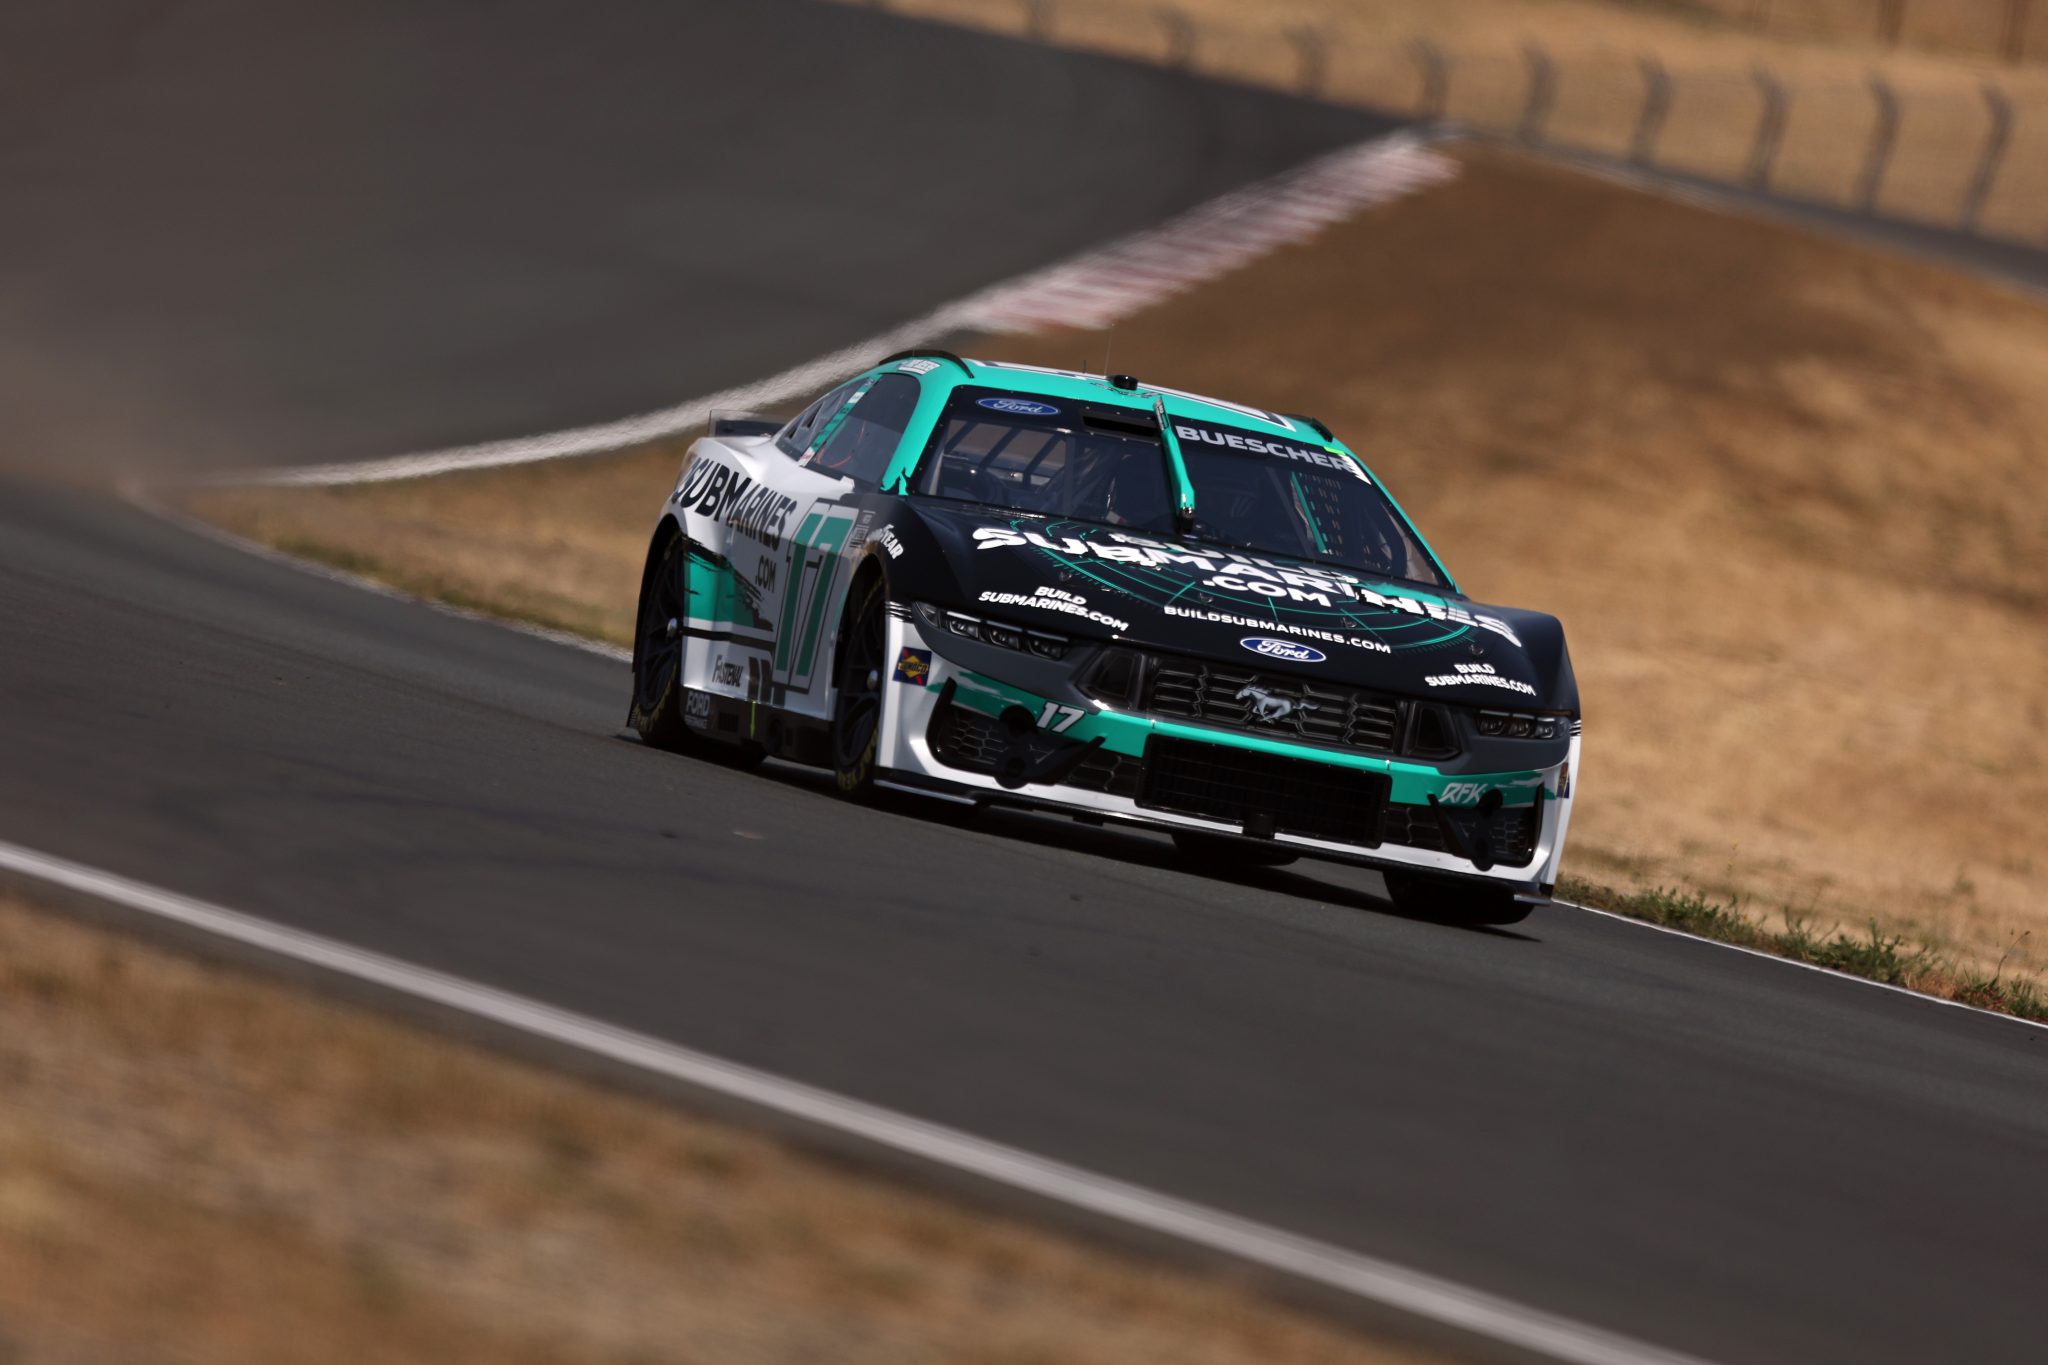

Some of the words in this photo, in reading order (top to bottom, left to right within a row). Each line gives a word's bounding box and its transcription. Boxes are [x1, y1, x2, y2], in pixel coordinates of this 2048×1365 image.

[1175, 424, 1357, 473] BUESCHER
[671, 456, 798, 552] SUBMARINES
[755, 554, 777, 593] .COM
[973, 527, 1523, 648] SUBMARINES
[1202, 575, 1332, 607] .COM
[770, 500, 859, 692] 17
[978, 590, 1130, 632] SUBMARINES.COM
[1034, 585, 1087, 606] BUILD
[1163, 605, 1393, 655] BUILDSUBMARINES.COM
[1424, 674, 1538, 697] SUBMARINES.COM
[1454, 663, 1496, 675] BUILD
[1036, 701, 1086, 734] 17
[1438, 782, 1489, 804] RFK
